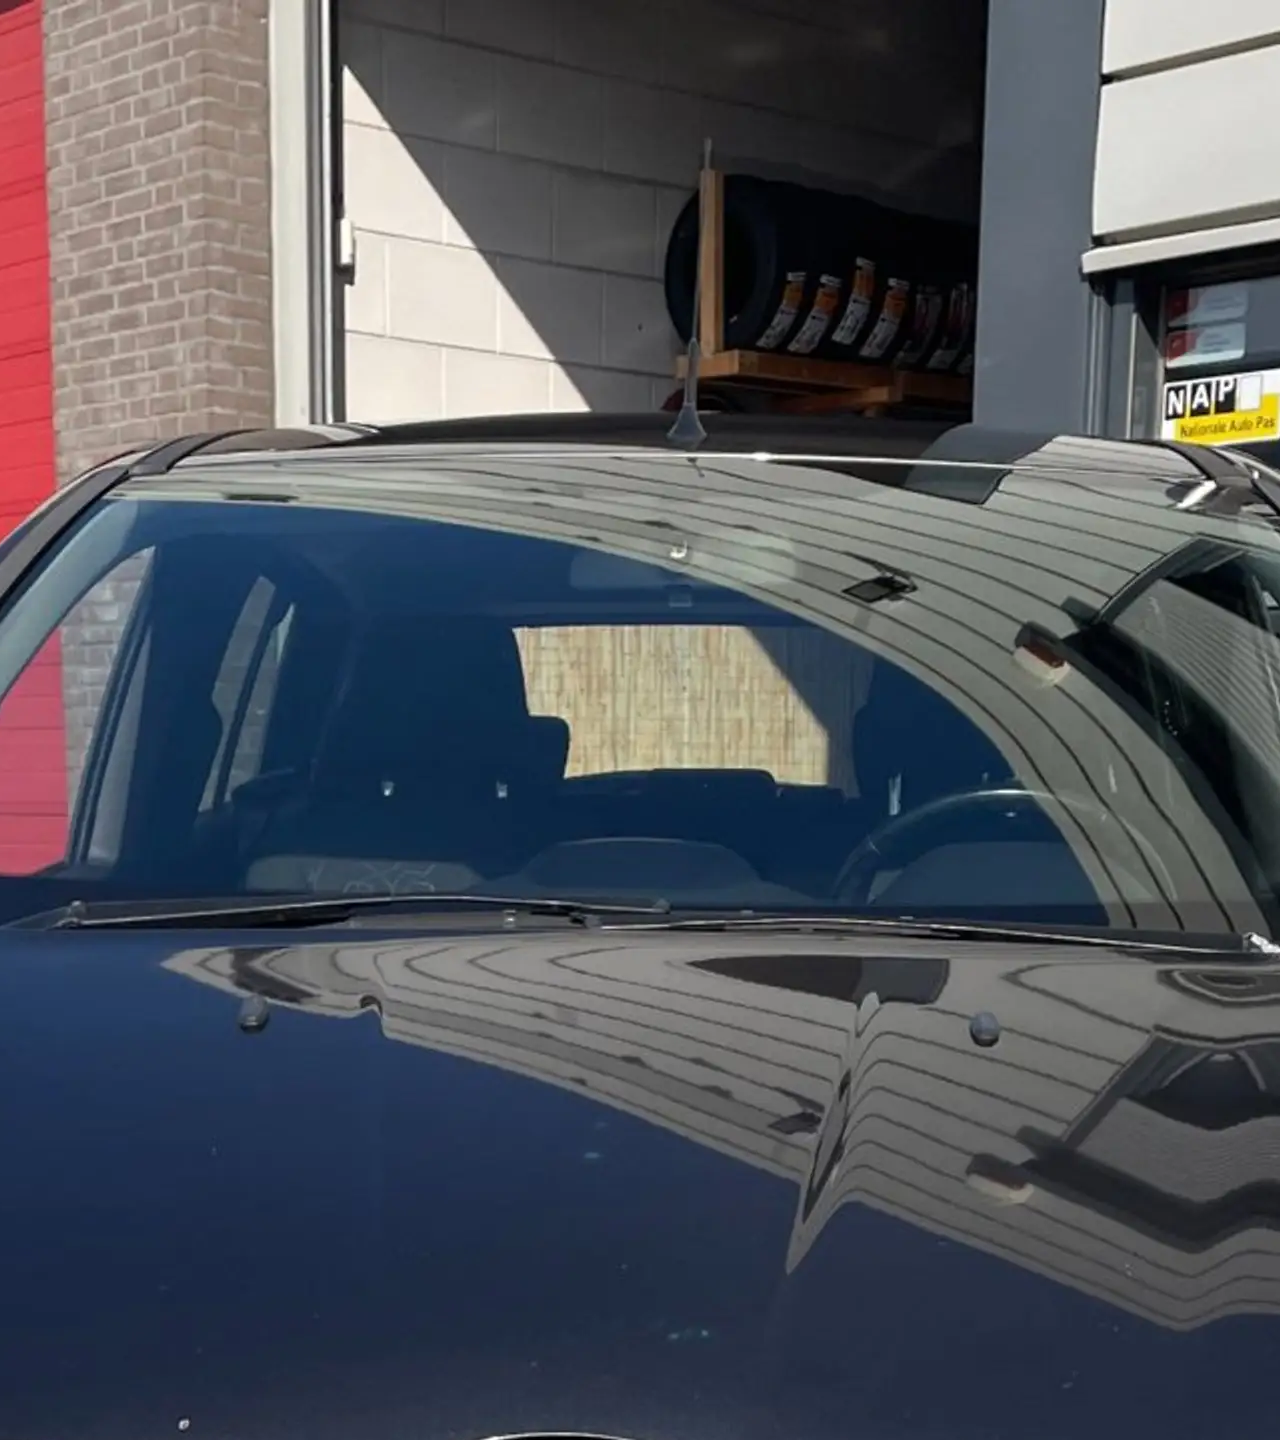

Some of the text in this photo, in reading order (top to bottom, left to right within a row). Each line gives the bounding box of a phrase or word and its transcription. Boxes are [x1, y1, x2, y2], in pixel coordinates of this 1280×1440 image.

[1168, 378, 1236, 416] NAP
[1229, 418, 1254, 433] Auto
[1256, 415, 1276, 429] Pas
